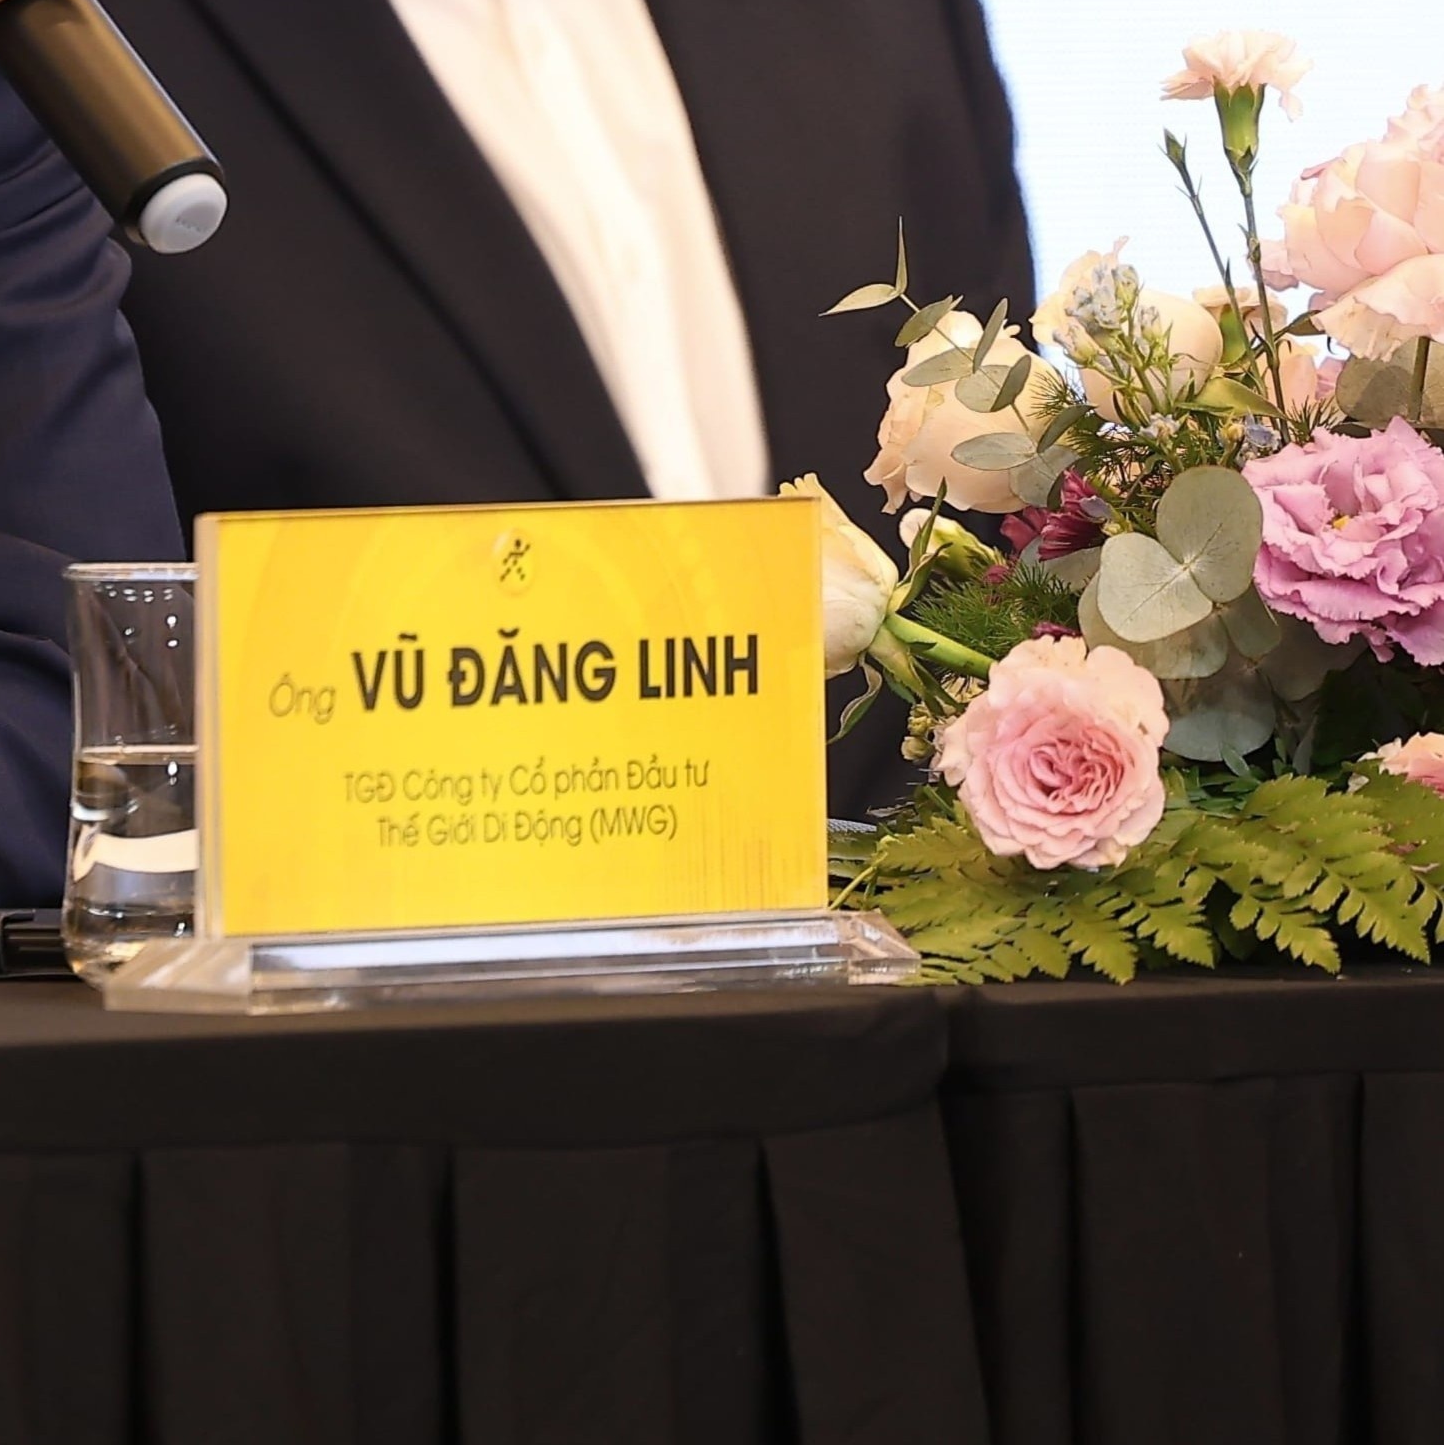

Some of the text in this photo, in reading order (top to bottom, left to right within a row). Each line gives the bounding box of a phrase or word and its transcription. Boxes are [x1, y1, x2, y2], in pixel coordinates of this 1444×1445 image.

[269, 627, 758, 725] Ông VŨ ĐĂNG LINH
[344, 753, 710, 806] TGĐ Công ty Cổ phần Đầu tư
[377, 804, 678, 848] Thế Giới Di Động (MWG)
